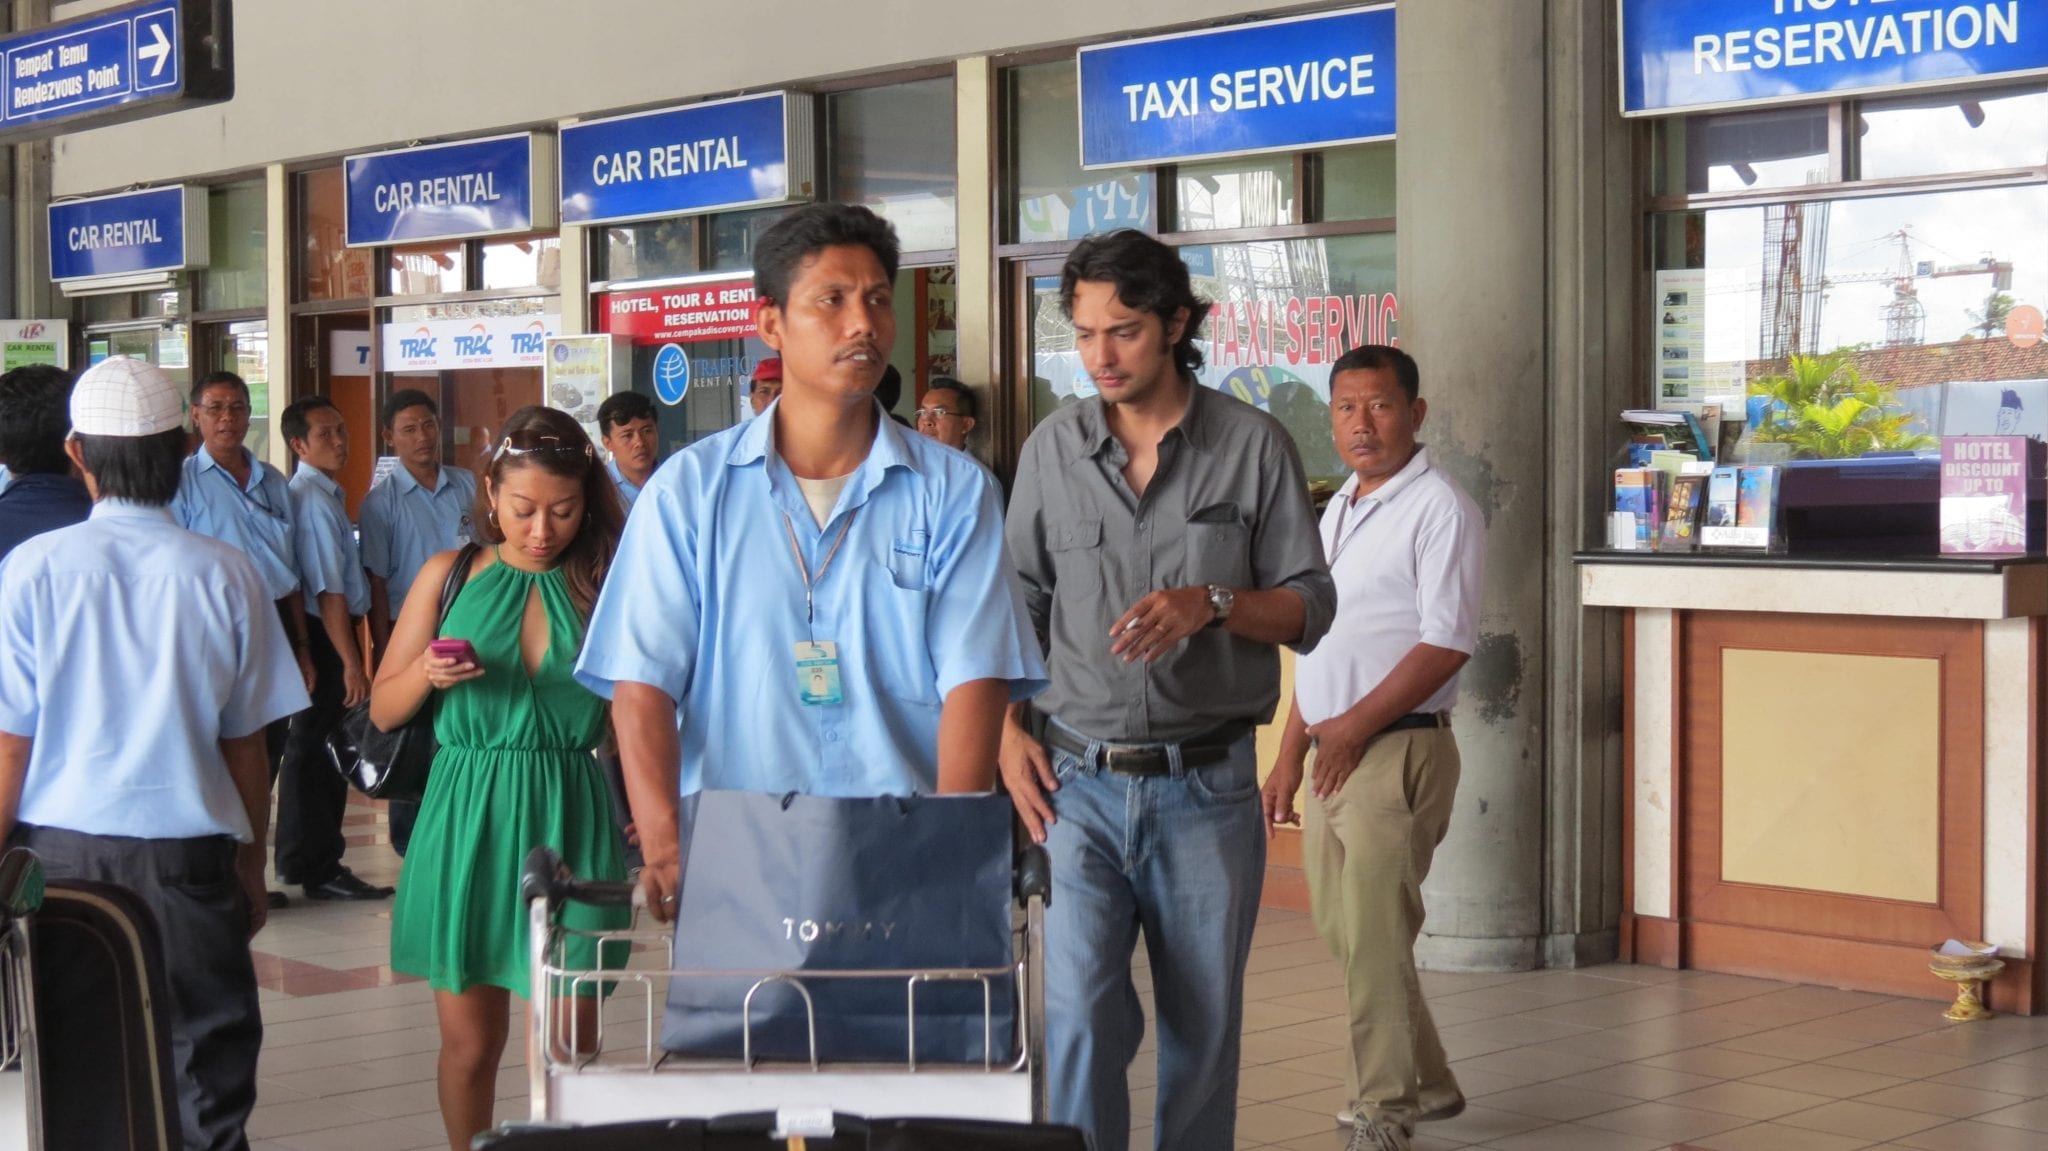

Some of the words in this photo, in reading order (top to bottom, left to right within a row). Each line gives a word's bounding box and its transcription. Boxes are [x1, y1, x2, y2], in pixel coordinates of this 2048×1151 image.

[1693, 1, 2018, 74] RESERVATION
[15, 48, 54, 79] Tempat
[59, 43, 89, 68] Temu
[14, 75, 83, 109] Rendezvous
[88, 63, 120, 92] Point
[1123, 77, 1199, 122] TAXI
[1209, 54, 1374, 113] SERVICE
[592, 150, 643, 186] CAR
[649, 137, 747, 178] RENTAL
[374, 183, 414, 213] CAR
[420, 172, 500, 206] RENTAL
[68, 226, 99, 252] CAR
[103, 218, 162, 246] RENTAL
[612, 298, 660, 314] HOTEL,
[662, 294, 701, 309] TOUR
[705, 291, 716, 306] &
[664, 308, 749, 327] RESERVATION
[454, 334, 493, 356] TRAC
[511, 331, 552, 354] TRA
[1208, 301, 1276, 367] TAXI
[26, 344, 55, 352] RENTAL
[400, 338, 437, 358] TRAC
[693, 377, 720, 388] RENT
[726, 376, 733, 386] A
[1954, 442, 2013, 460] HOTEL
[1945, 462, 2021, 477] DISCOUNT
[1963, 478, 1982, 492] UP
[1986, 478, 2004, 492] TO
